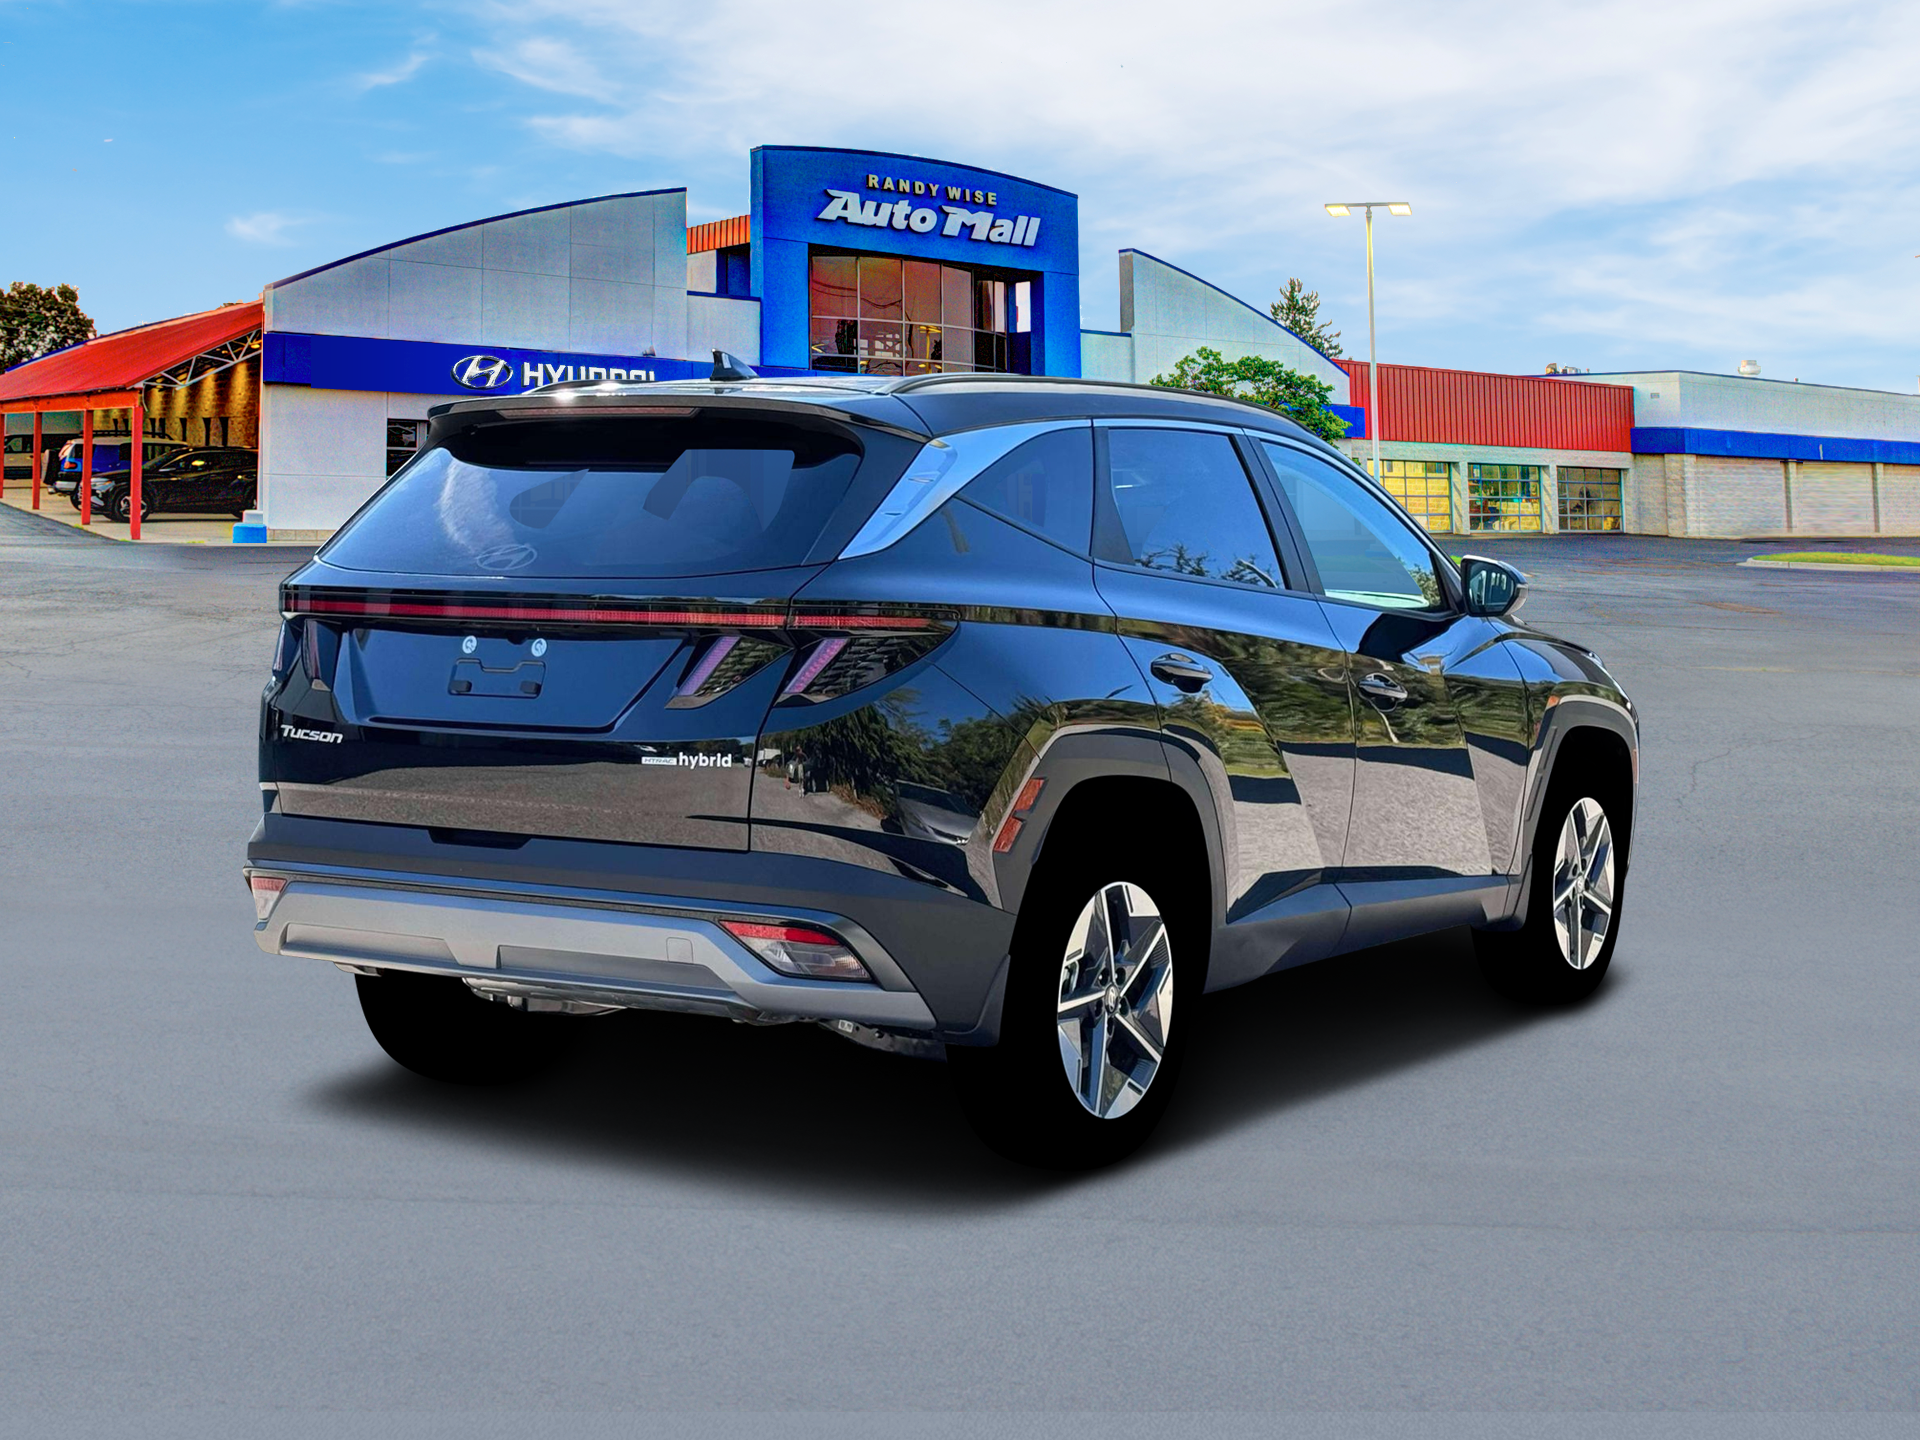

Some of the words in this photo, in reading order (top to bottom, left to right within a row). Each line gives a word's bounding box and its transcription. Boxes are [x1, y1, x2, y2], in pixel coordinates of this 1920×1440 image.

[867, 174, 939, 197] RANDY
[947, 186, 997, 206] WISE
[816, 189, 938, 233] Auto
[941, 205, 1041, 247] Mall
[678, 751, 732, 770] hybrid
